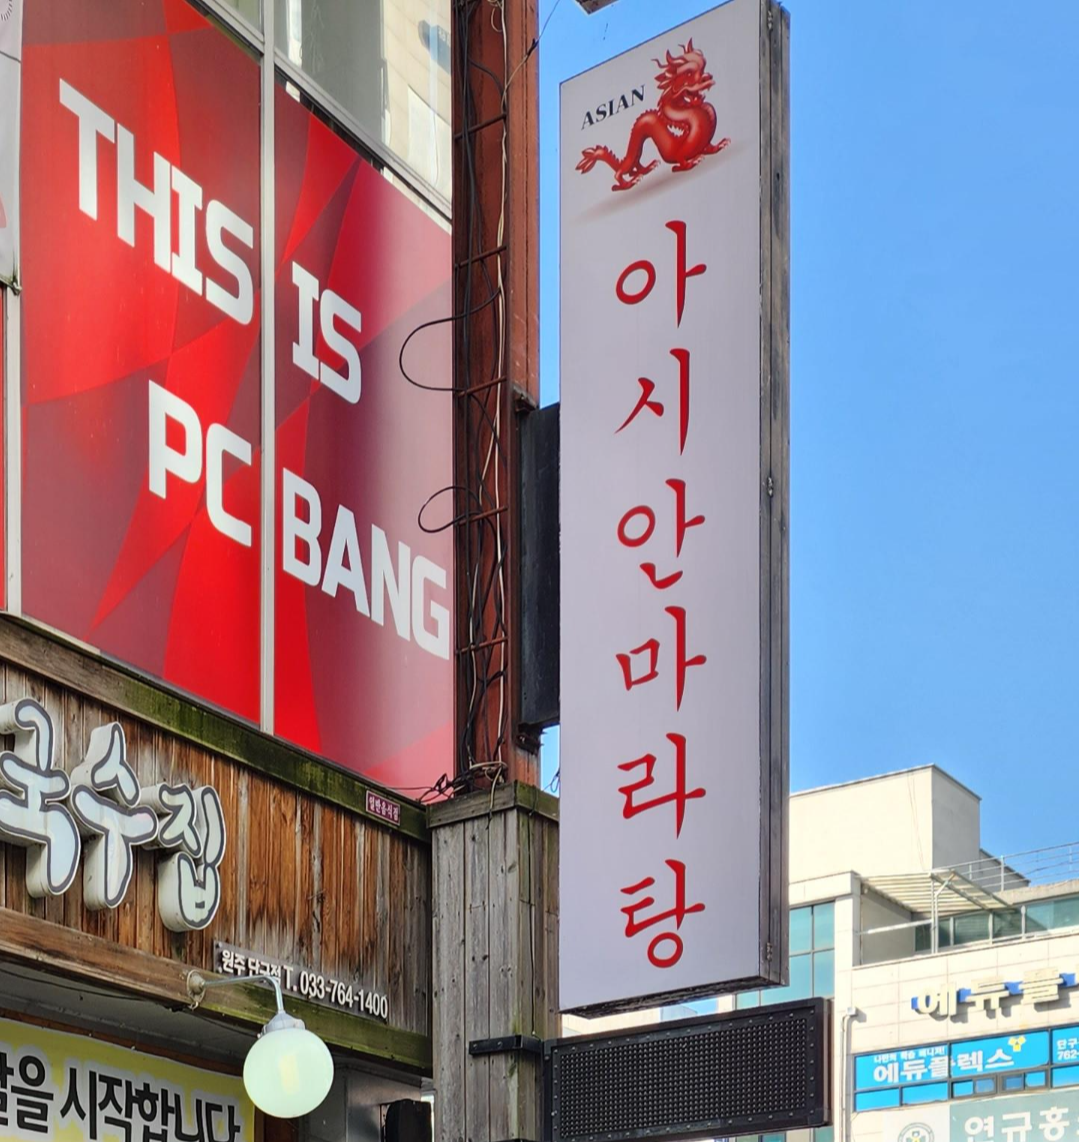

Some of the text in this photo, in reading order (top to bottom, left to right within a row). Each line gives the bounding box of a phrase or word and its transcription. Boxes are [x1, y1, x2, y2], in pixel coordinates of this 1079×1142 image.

[581, 84, 646, 131] ASIAN
[59, 79, 363, 404] THIS IS
[148, 379, 451, 661] PC BANG
[222, 949, 245, 976] 원주
[299, 970, 388, 1019] 033-764-1400
